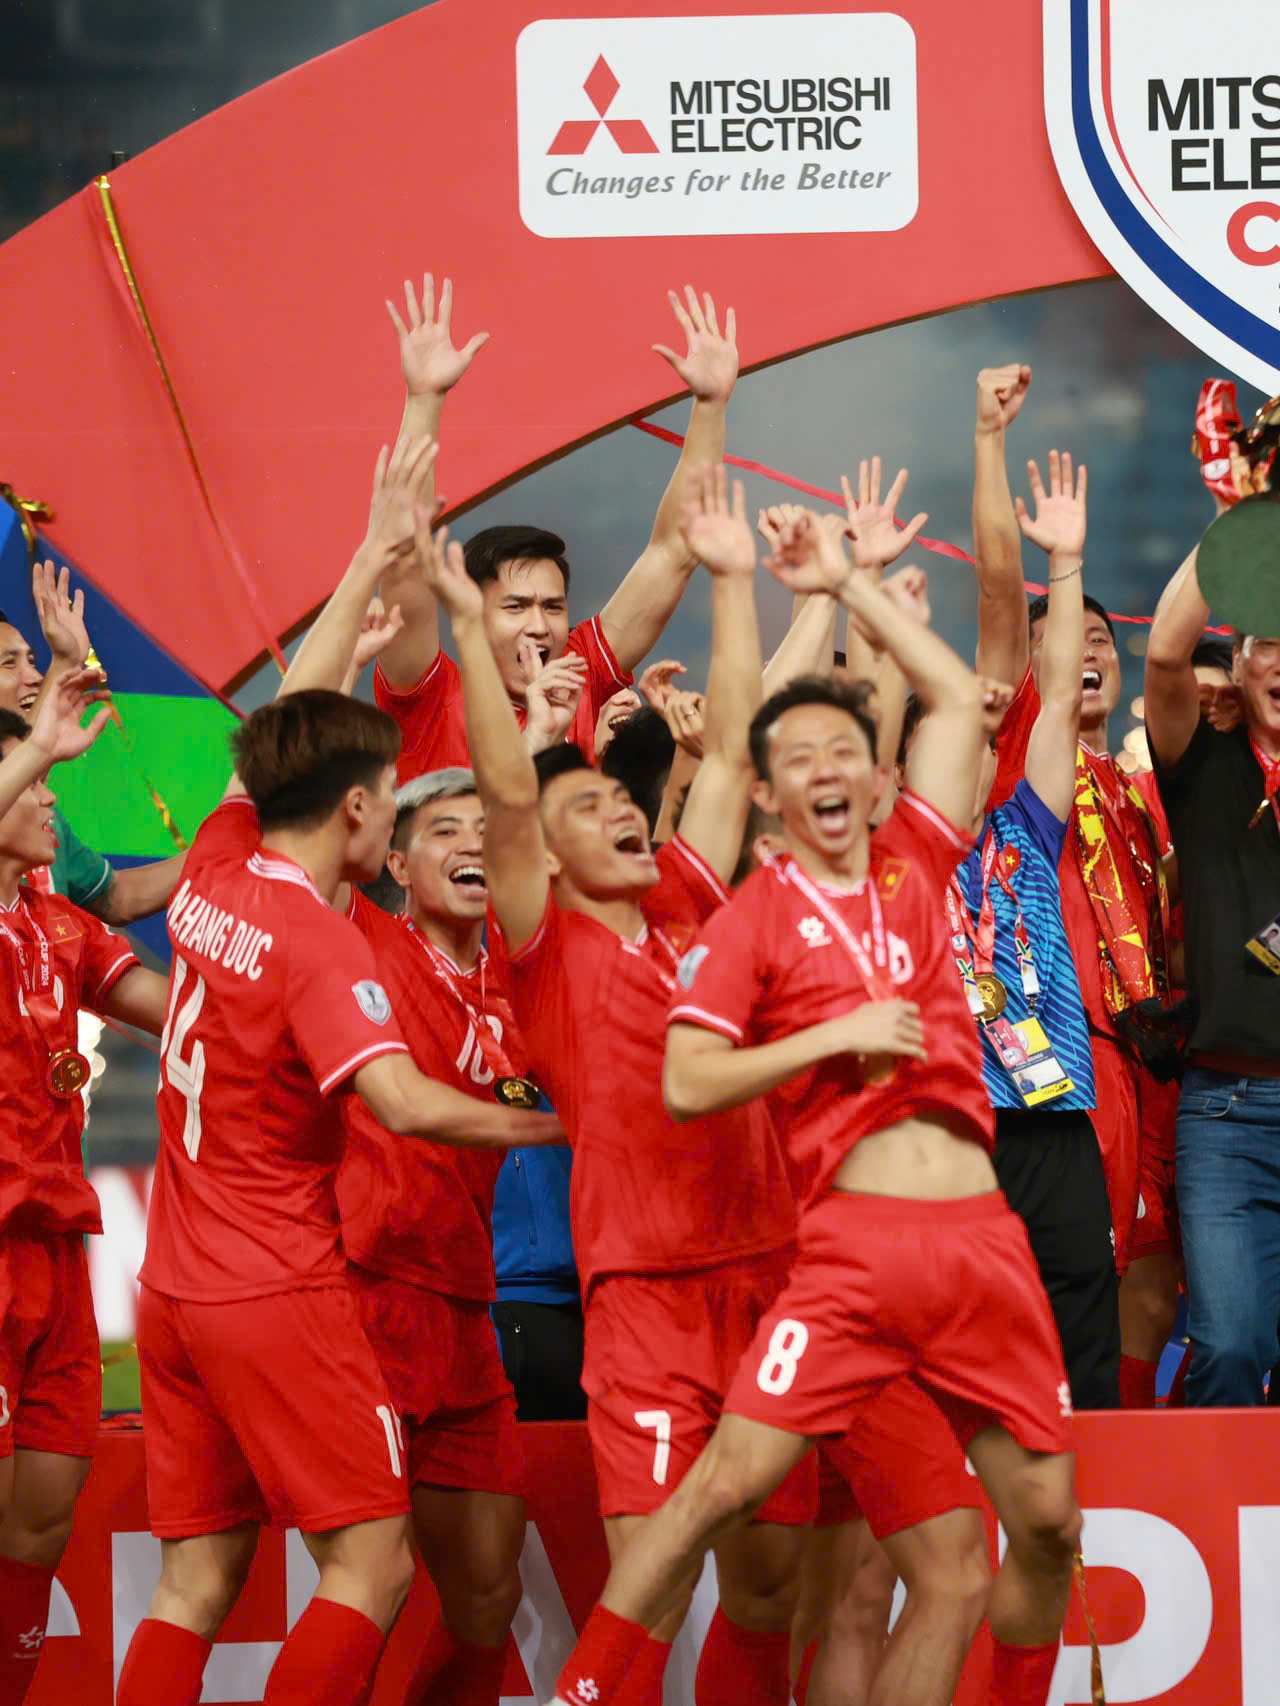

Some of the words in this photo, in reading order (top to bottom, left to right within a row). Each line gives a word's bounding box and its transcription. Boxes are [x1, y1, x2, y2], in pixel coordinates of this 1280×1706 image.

[670, 77, 891, 115] MITSUBISHI
[671, 116, 862, 153] ELECTRIC
[546, 168, 675, 198] Changes
[684, 168, 730, 196] for
[740, 168, 785, 192] the
[797, 162, 892, 191] Better
[222, 920, 273, 981] DUC
[757, 1318, 809, 1396] 8
[376, 1403, 404, 1478] 1
[634, 1410, 671, 1485] 7
